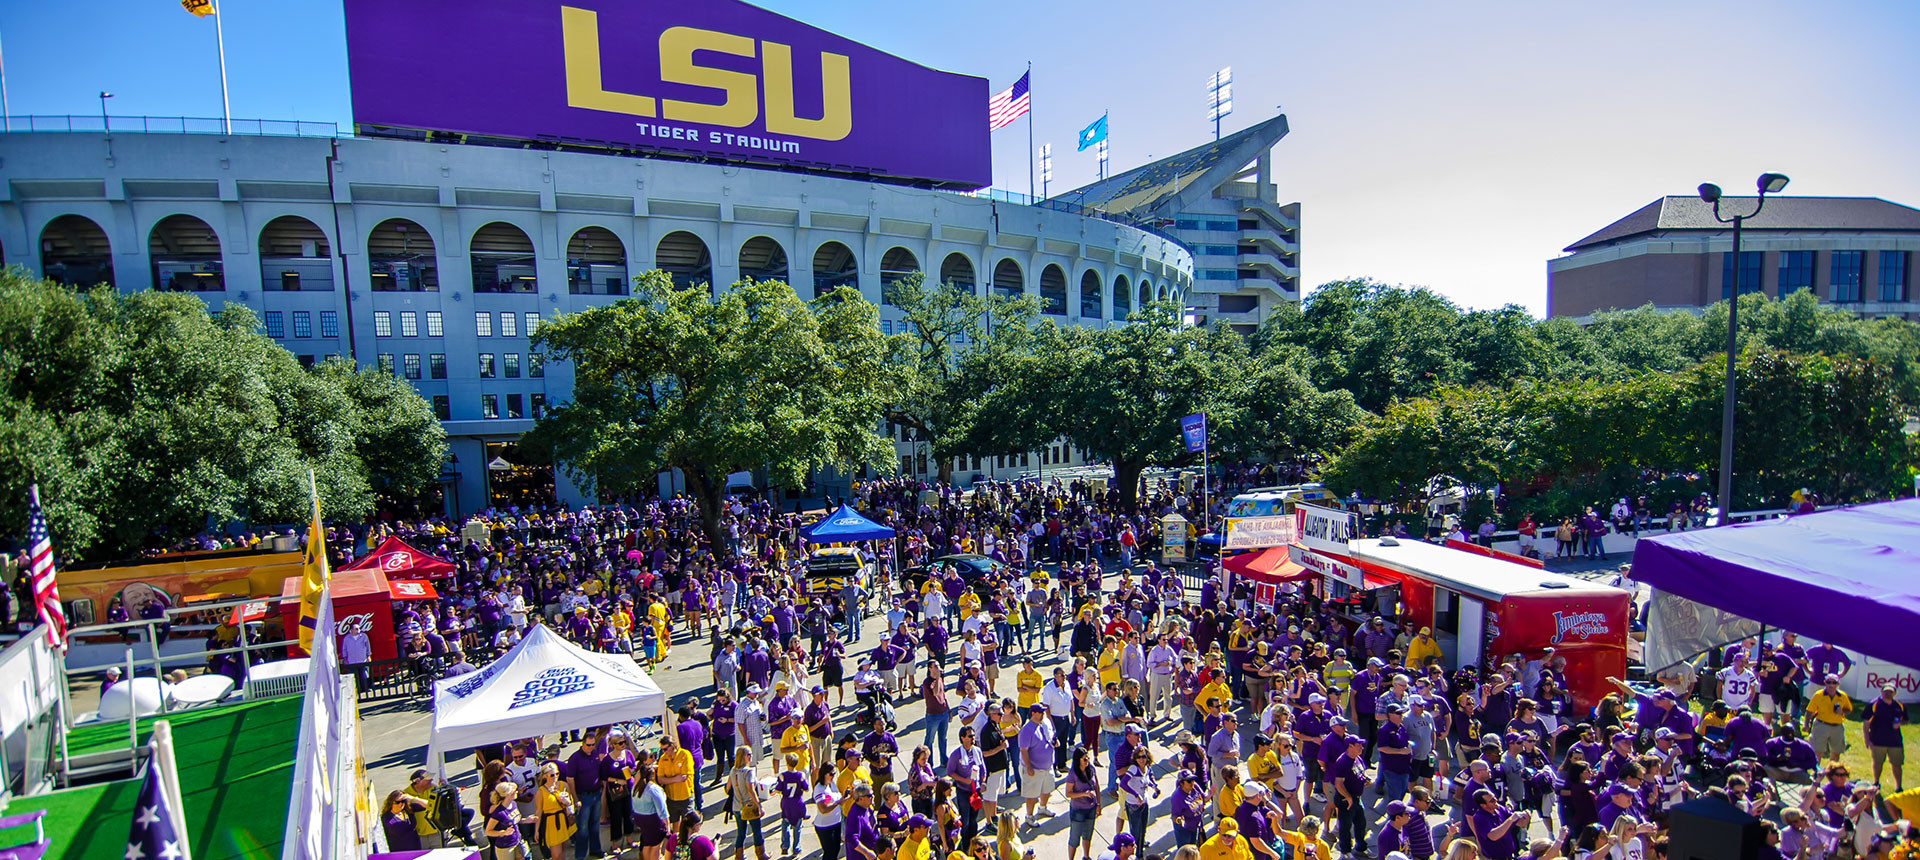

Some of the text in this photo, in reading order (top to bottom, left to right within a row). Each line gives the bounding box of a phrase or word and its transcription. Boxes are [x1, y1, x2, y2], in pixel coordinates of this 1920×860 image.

[561, 5, 852, 141] LSU
[636, 122, 800, 154] TIGER STADIUM
[1305, 514, 1329, 540] ALLIGATOR
[1331, 519, 1350, 545] BALLS
[338, 613, 374, 635] Cla
[1550, 610, 1605, 644] Jambalaya
[1580, 623, 1608, 640] Shake
[512, 681, 595, 702] SPORT
[524, 674, 588, 691] GOOD
[1728, 680, 1748, 695] 33
[1867, 672, 1920, 693] Reddy
[522, 769, 536, 789] 5
[786, 783, 797, 798] 7
